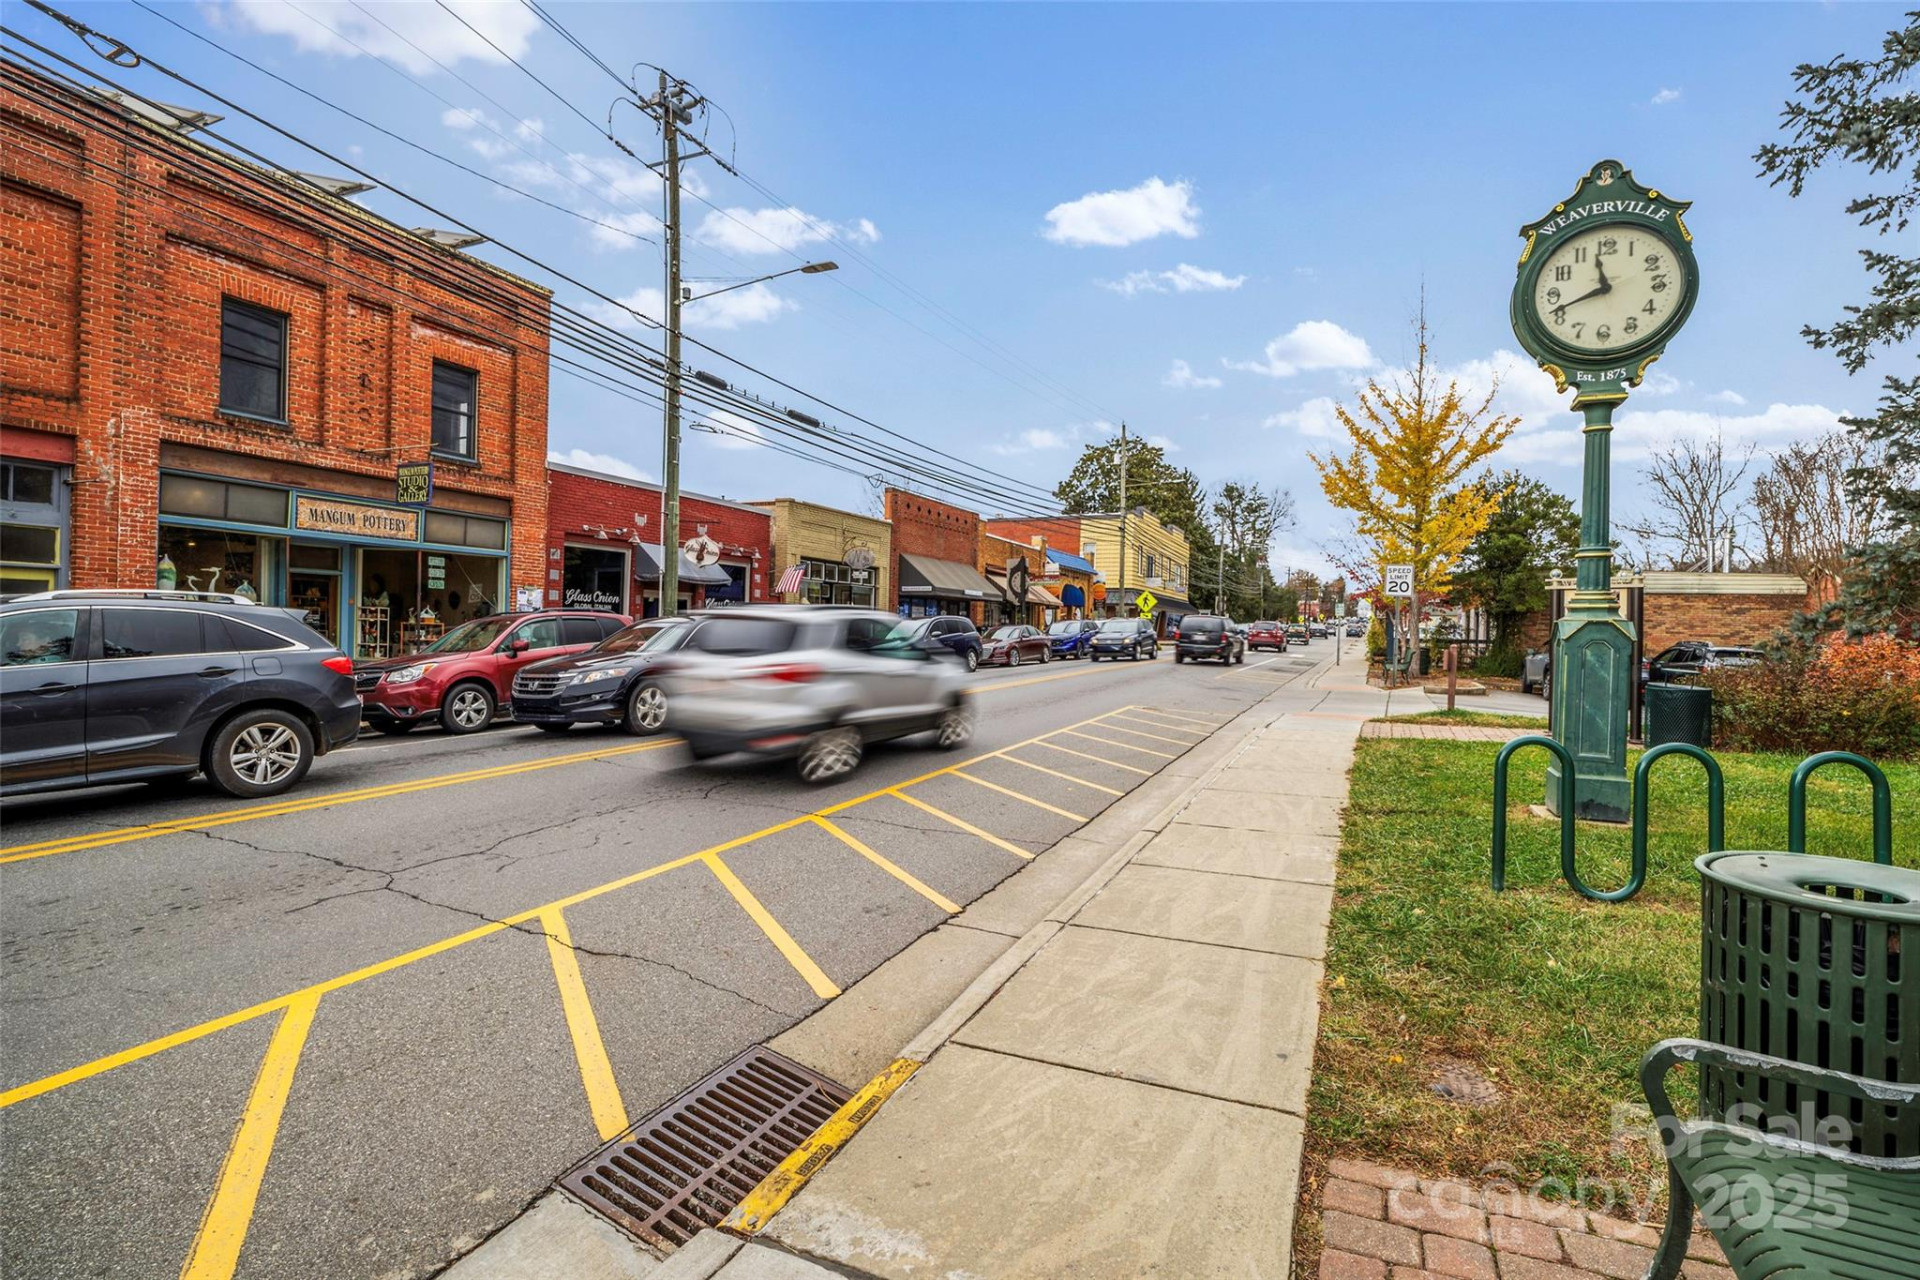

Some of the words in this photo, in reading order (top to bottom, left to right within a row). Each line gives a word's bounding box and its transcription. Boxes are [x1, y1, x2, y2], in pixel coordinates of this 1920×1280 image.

[1539, 200, 1670, 236] WEAVERVILLE
[1575, 246, 1587, 264] 11
[1597, 238, 1618, 256] 12
[1629, 241, 1635, 257] 1
[1644, 254, 1660, 272] 2
[1555, 265, 1572, 282] 10
[1651, 274, 1667, 293] 3
[1547, 287, 1561, 305] 9
[1554, 305, 1566, 326] 8
[1642, 299, 1657, 316] 4
[1571, 322, 1586, 339] 7
[1596, 324, 1611, 342] 6
[1624, 317, 1639, 334] 5
[1600, 368, 1627, 381] 1875
[398, 475, 429, 489] STUDIO
[408, 485, 419, 493] &
[398, 489, 428, 503] GALLERY
[309, 508, 355, 526] MANGUM
[363, 514, 406, 532] POTTERY
[1388, 581, 1409, 593] 20
[565, 588, 592, 605] Glass
[593, 591, 620, 603] Onion
